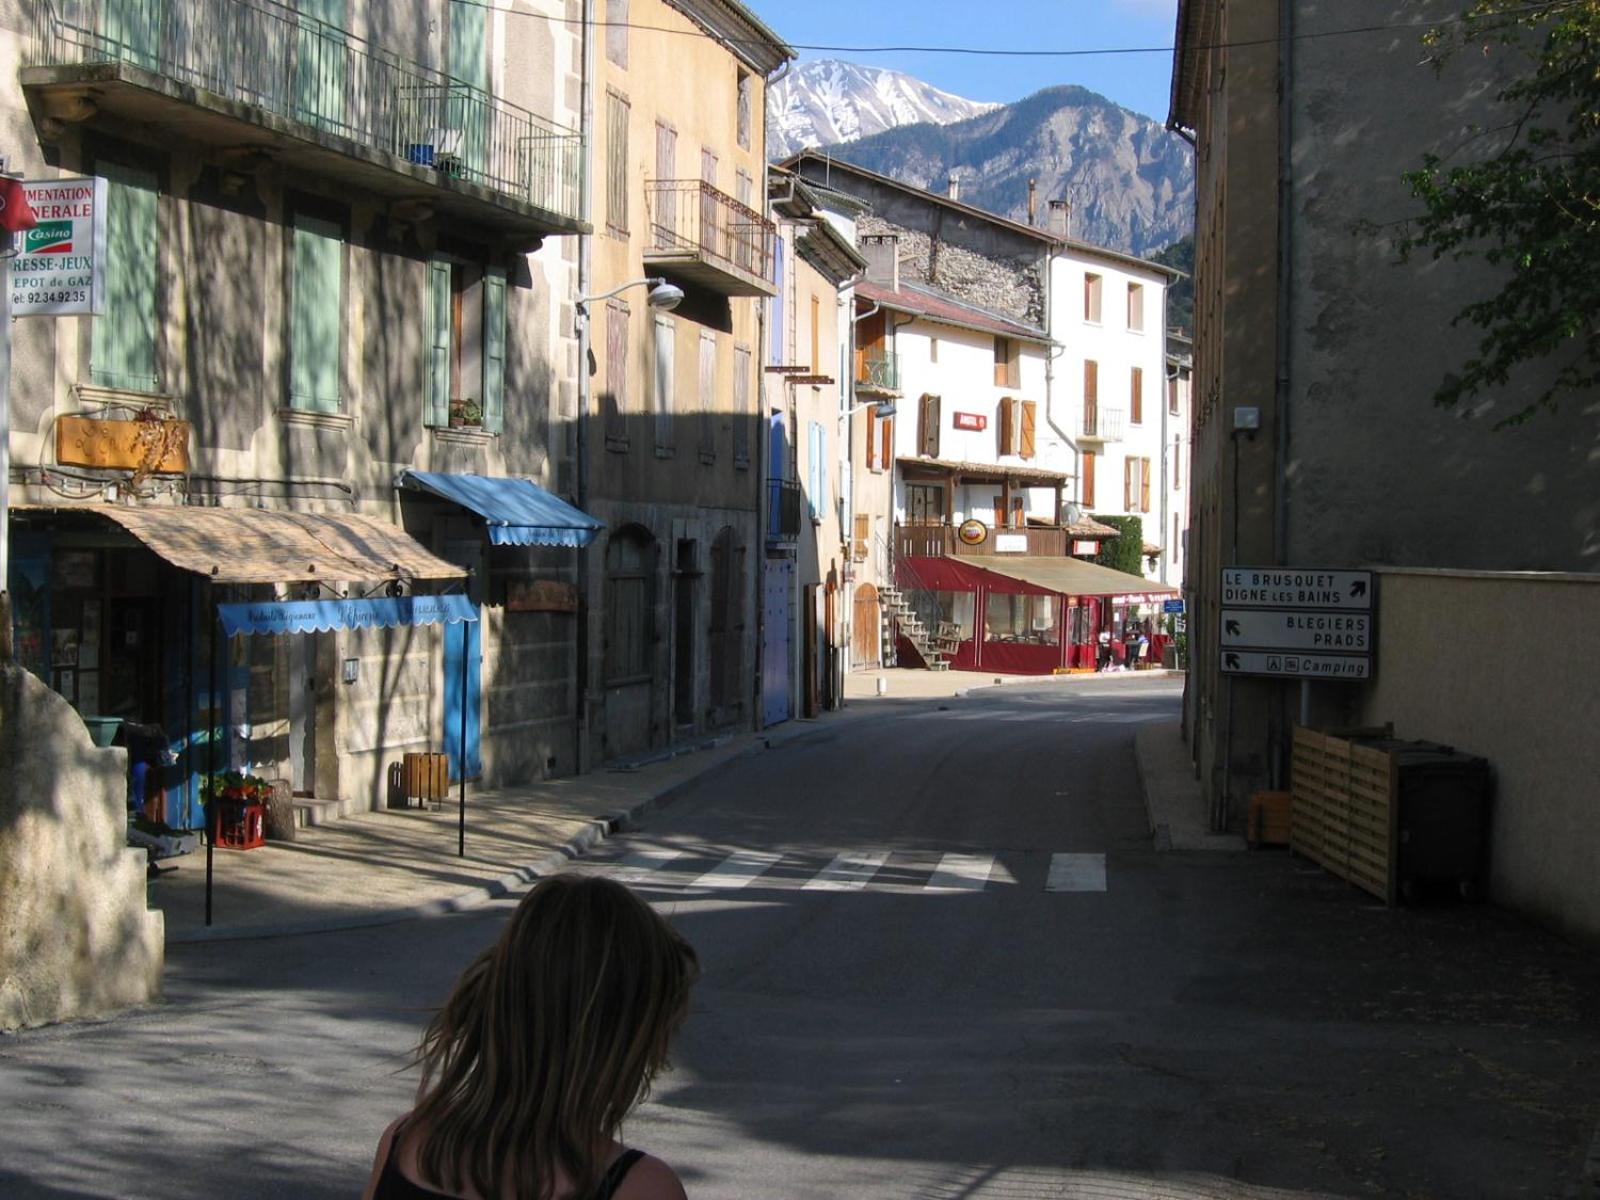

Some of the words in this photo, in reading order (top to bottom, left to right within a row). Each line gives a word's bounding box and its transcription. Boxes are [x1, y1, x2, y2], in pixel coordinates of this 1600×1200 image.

[28, 228, 70, 240] Casino
[50, 277, 63, 288] de
[68, 275, 92, 287] GAZ
[1226, 573, 1242, 586] LE
[1252, 574, 1335, 588] BRUSQUET
[1226, 588, 1267, 601] DIGNE
[1272, 591, 1293, 602] LES
[1298, 590, 1341, 603] BAINS
[1286, 616, 1365, 631] BLEGIERS
[1314, 633, 1365, 647] PRADS
[1303, 659, 1364, 676] Camping
